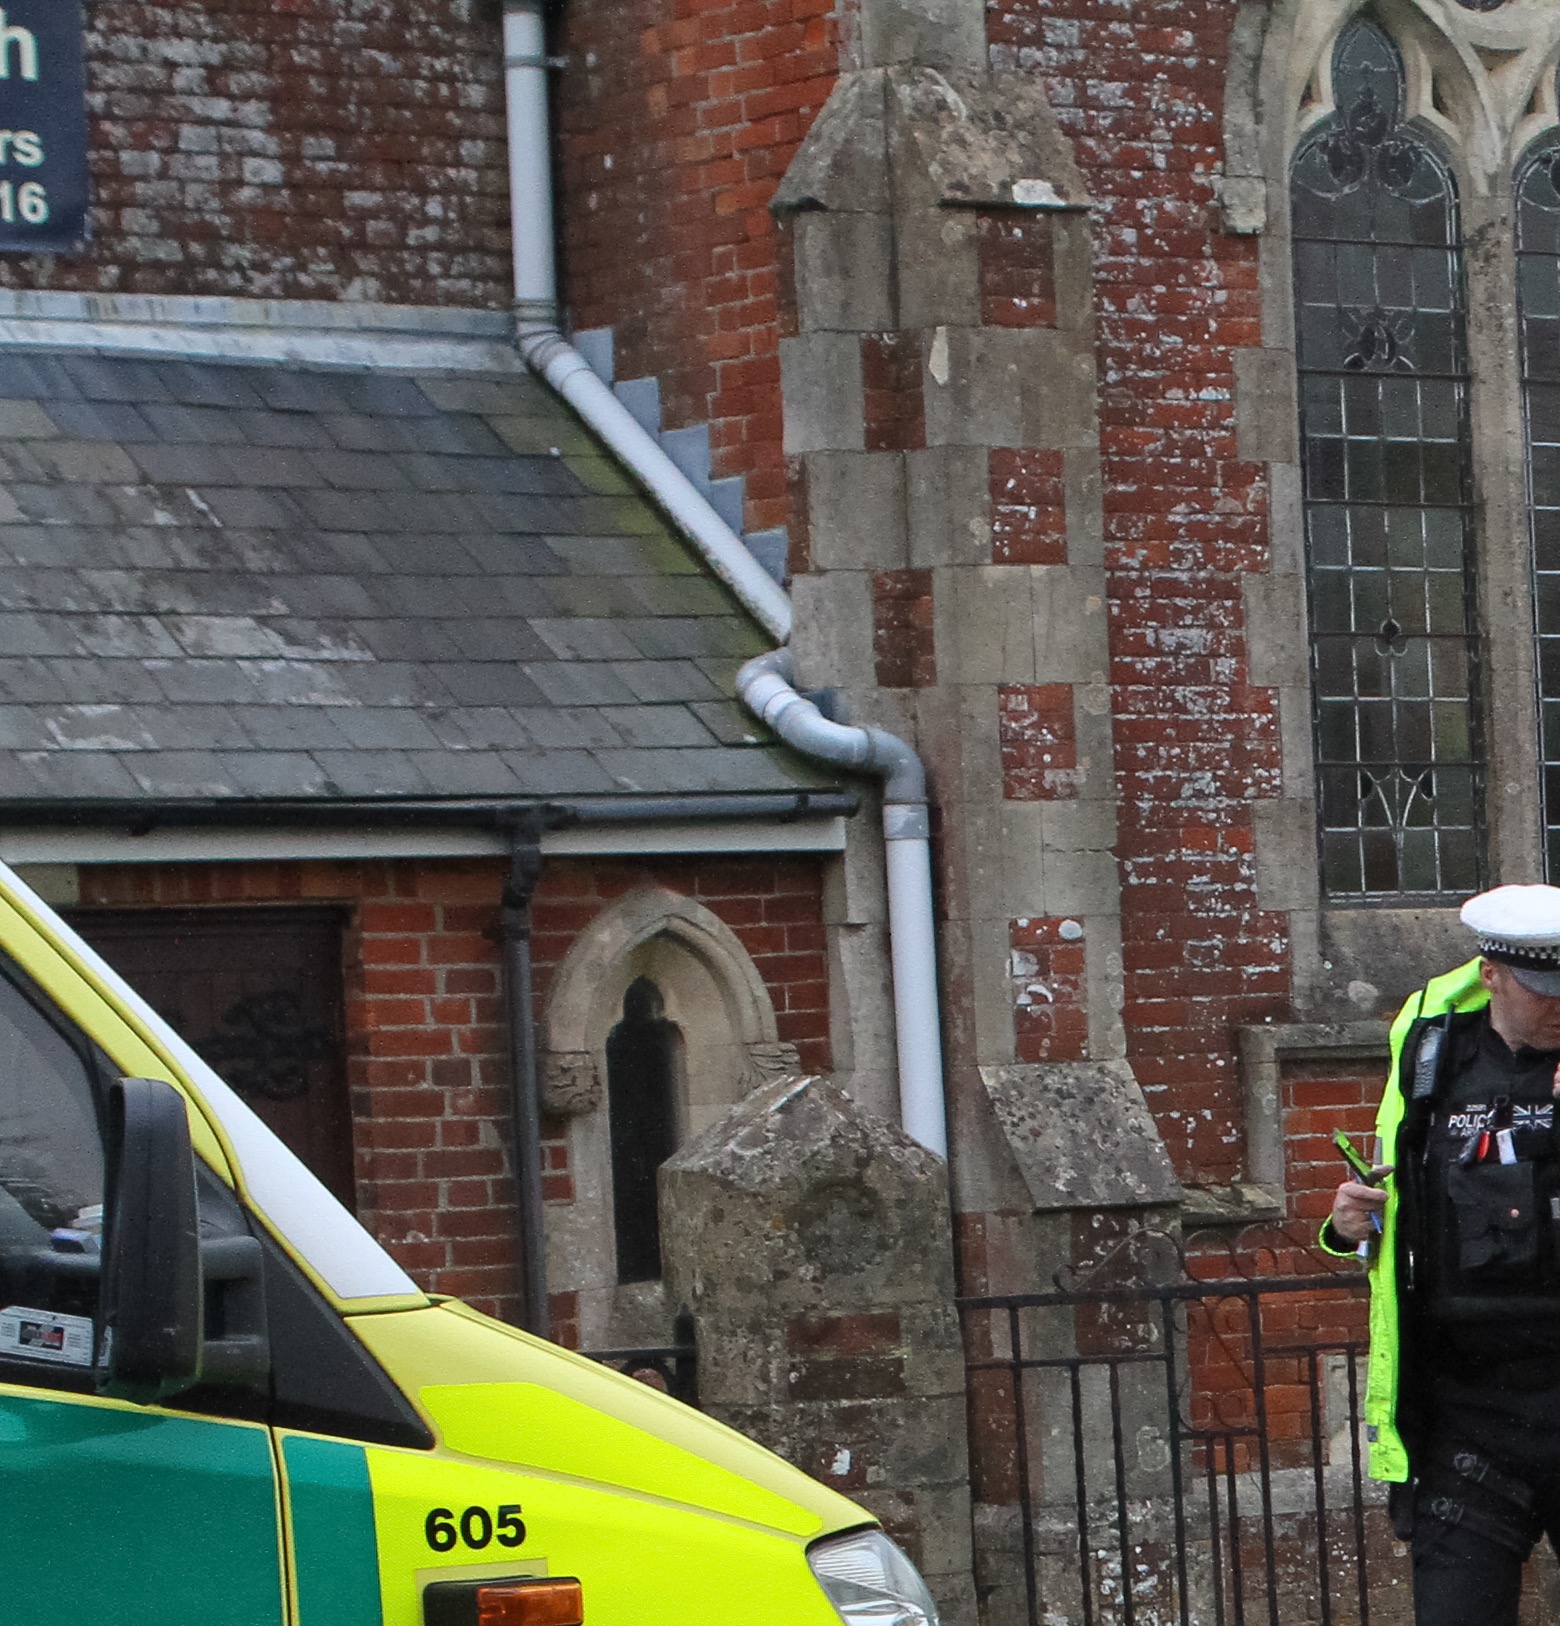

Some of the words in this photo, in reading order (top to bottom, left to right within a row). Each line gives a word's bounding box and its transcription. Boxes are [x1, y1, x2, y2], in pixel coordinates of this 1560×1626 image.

[0, 7, 39, 82] h
[0, 129, 45, 168] rs
[0, 179, 50, 224] 16
[1447, 1113, 1492, 1129] POLIC
[424, 1503, 527, 1553] 605
